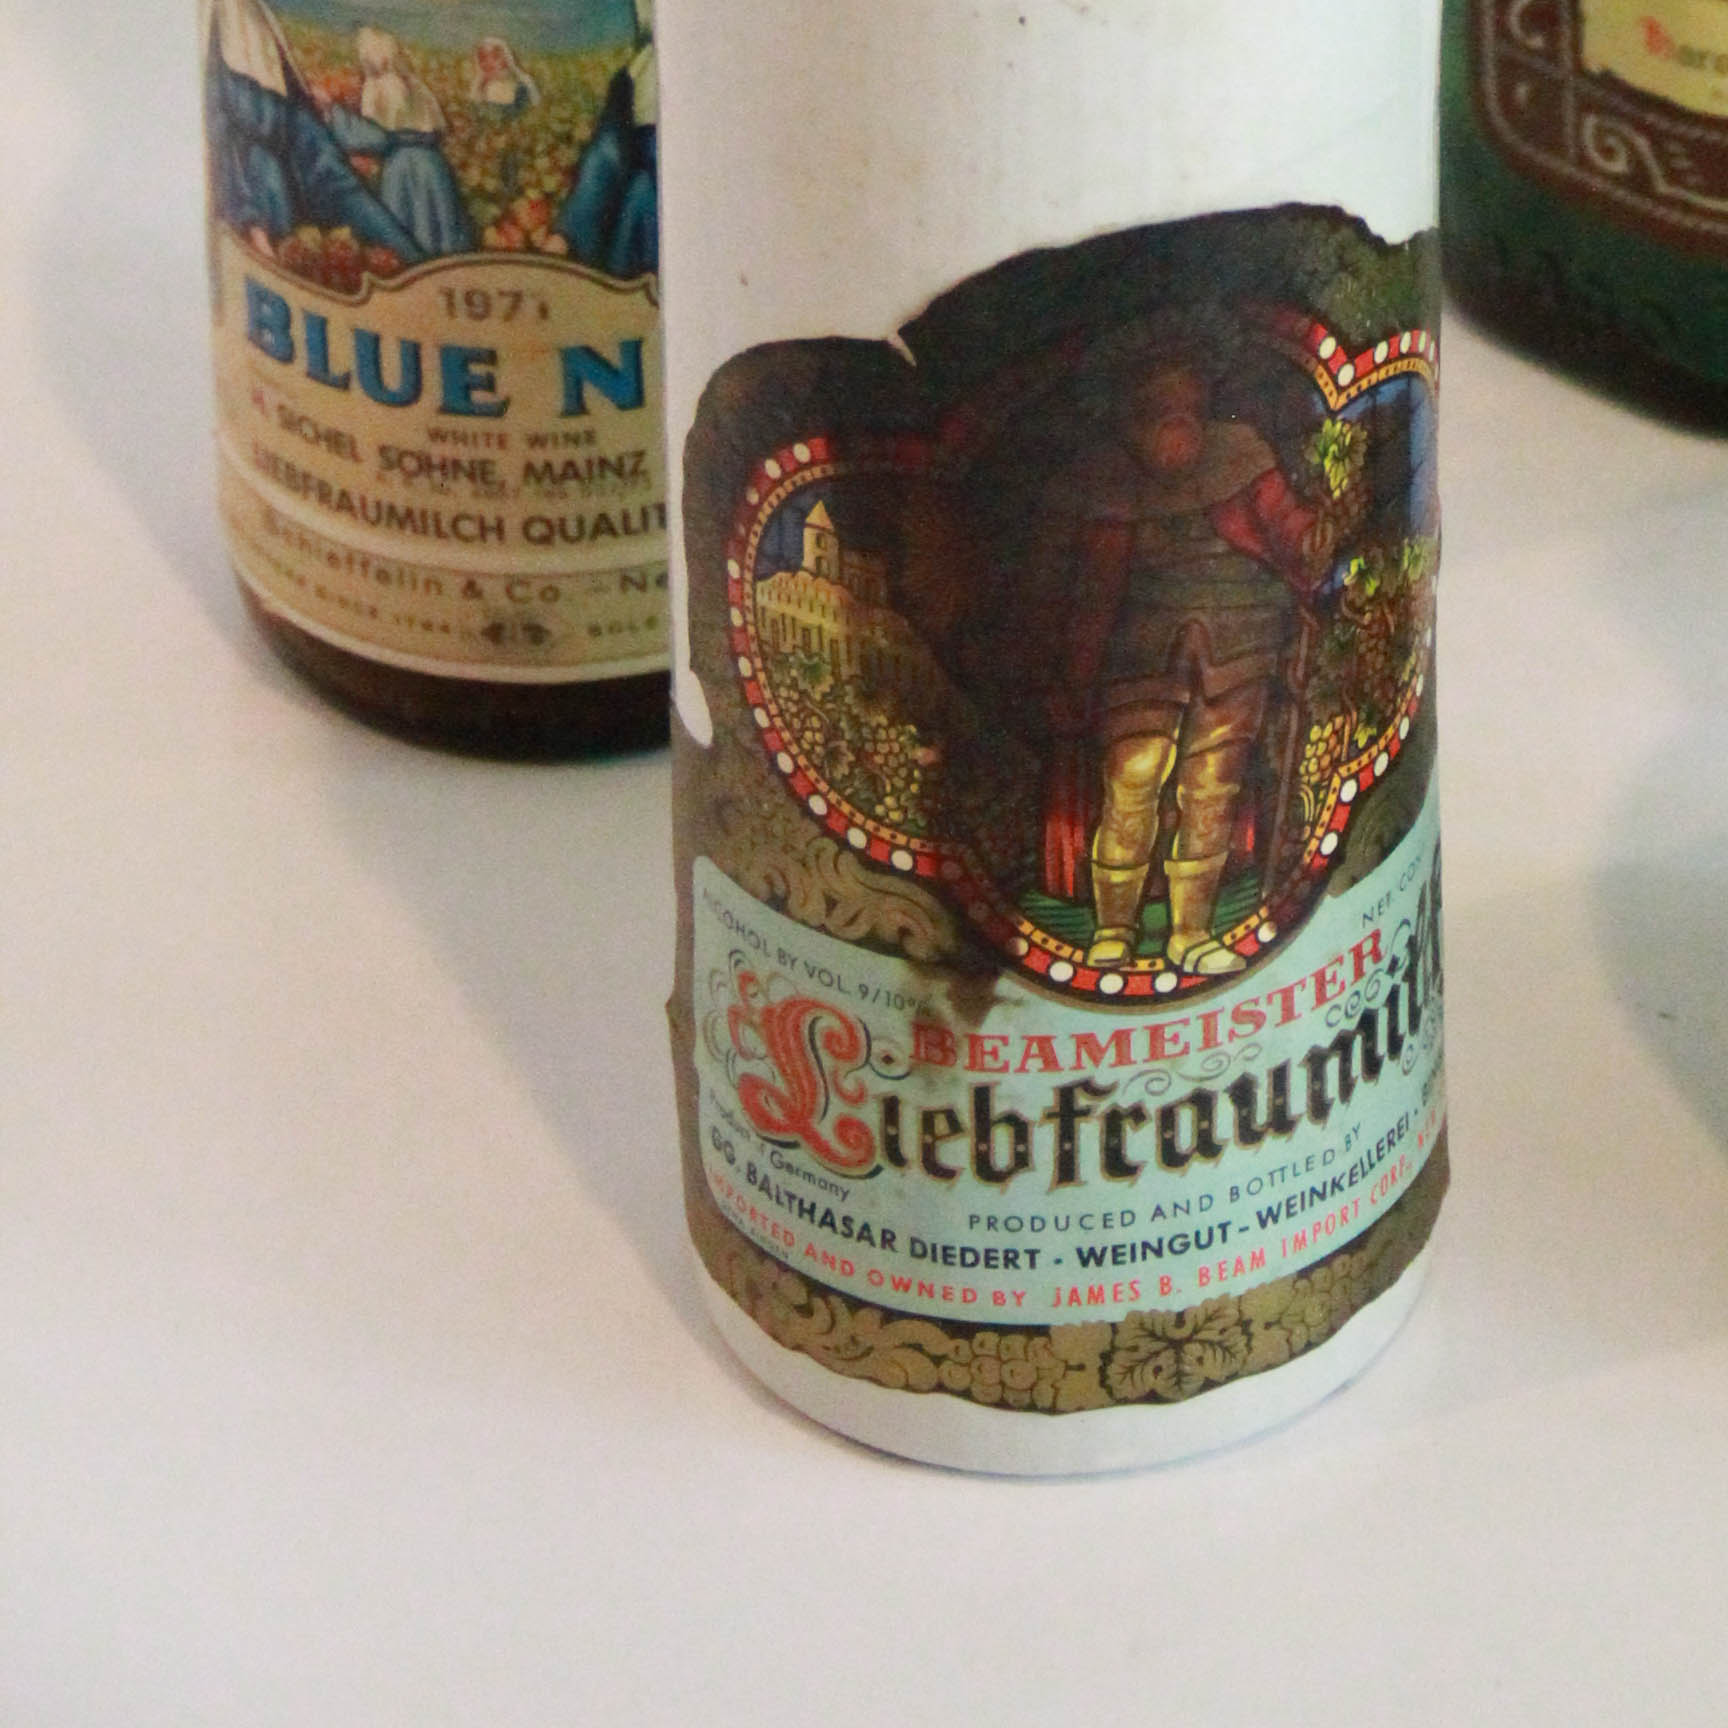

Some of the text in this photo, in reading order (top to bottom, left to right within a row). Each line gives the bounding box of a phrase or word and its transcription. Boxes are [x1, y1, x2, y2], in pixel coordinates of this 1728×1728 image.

[244, 275, 509, 418] BLUE
[427, 427, 596, 450] WHITE WINE
[522, 450, 649, 486] MAINZ
[777, 947, 798, 971] BY
[911, 928, 1388, 1075] BEAMEISTER
[746, 1160, 898, 1253] BALTHASAR
[910, 1235, 1041, 1271] DIEDERT
[770, 1149, 850, 1203] Germany
[969, 1121, 1361, 1233] PRODUCED AND BOTTLED BY
[804, 1241, 855, 1277] AND
[866, 1267, 978, 1304] OWNED
[992, 1289, 1027, 1308] BY
[1052, 1278, 1141, 1308] JAMES
[1158, 1275, 1183, 1297] B.
[1197, 1246, 1267, 1288] BEAM
[1281, 1196, 1361, 1259] IMPORT
